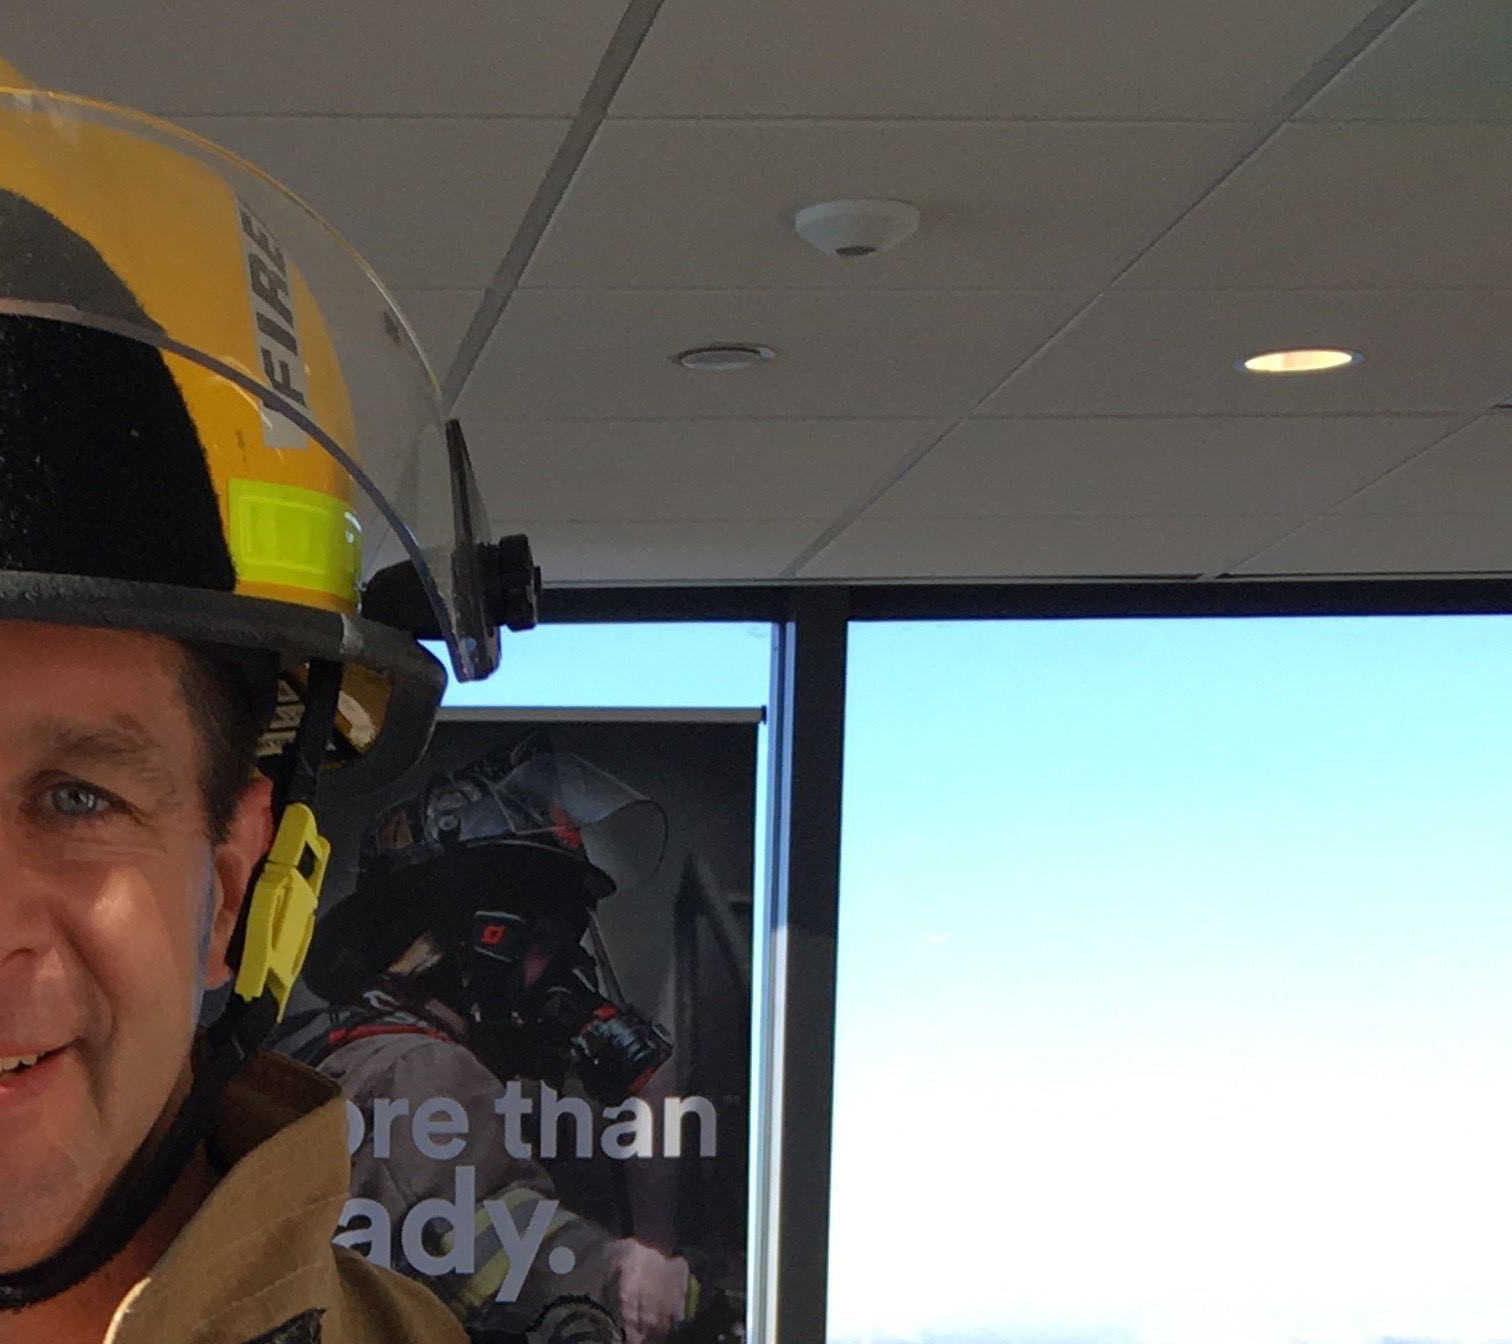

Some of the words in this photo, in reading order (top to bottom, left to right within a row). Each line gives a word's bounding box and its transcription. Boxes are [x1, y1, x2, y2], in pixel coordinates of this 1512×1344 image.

[238, 198, 310, 411] FIRE
[494, 1080, 718, 1160] than
[334, 1165, 577, 1304] ady.
